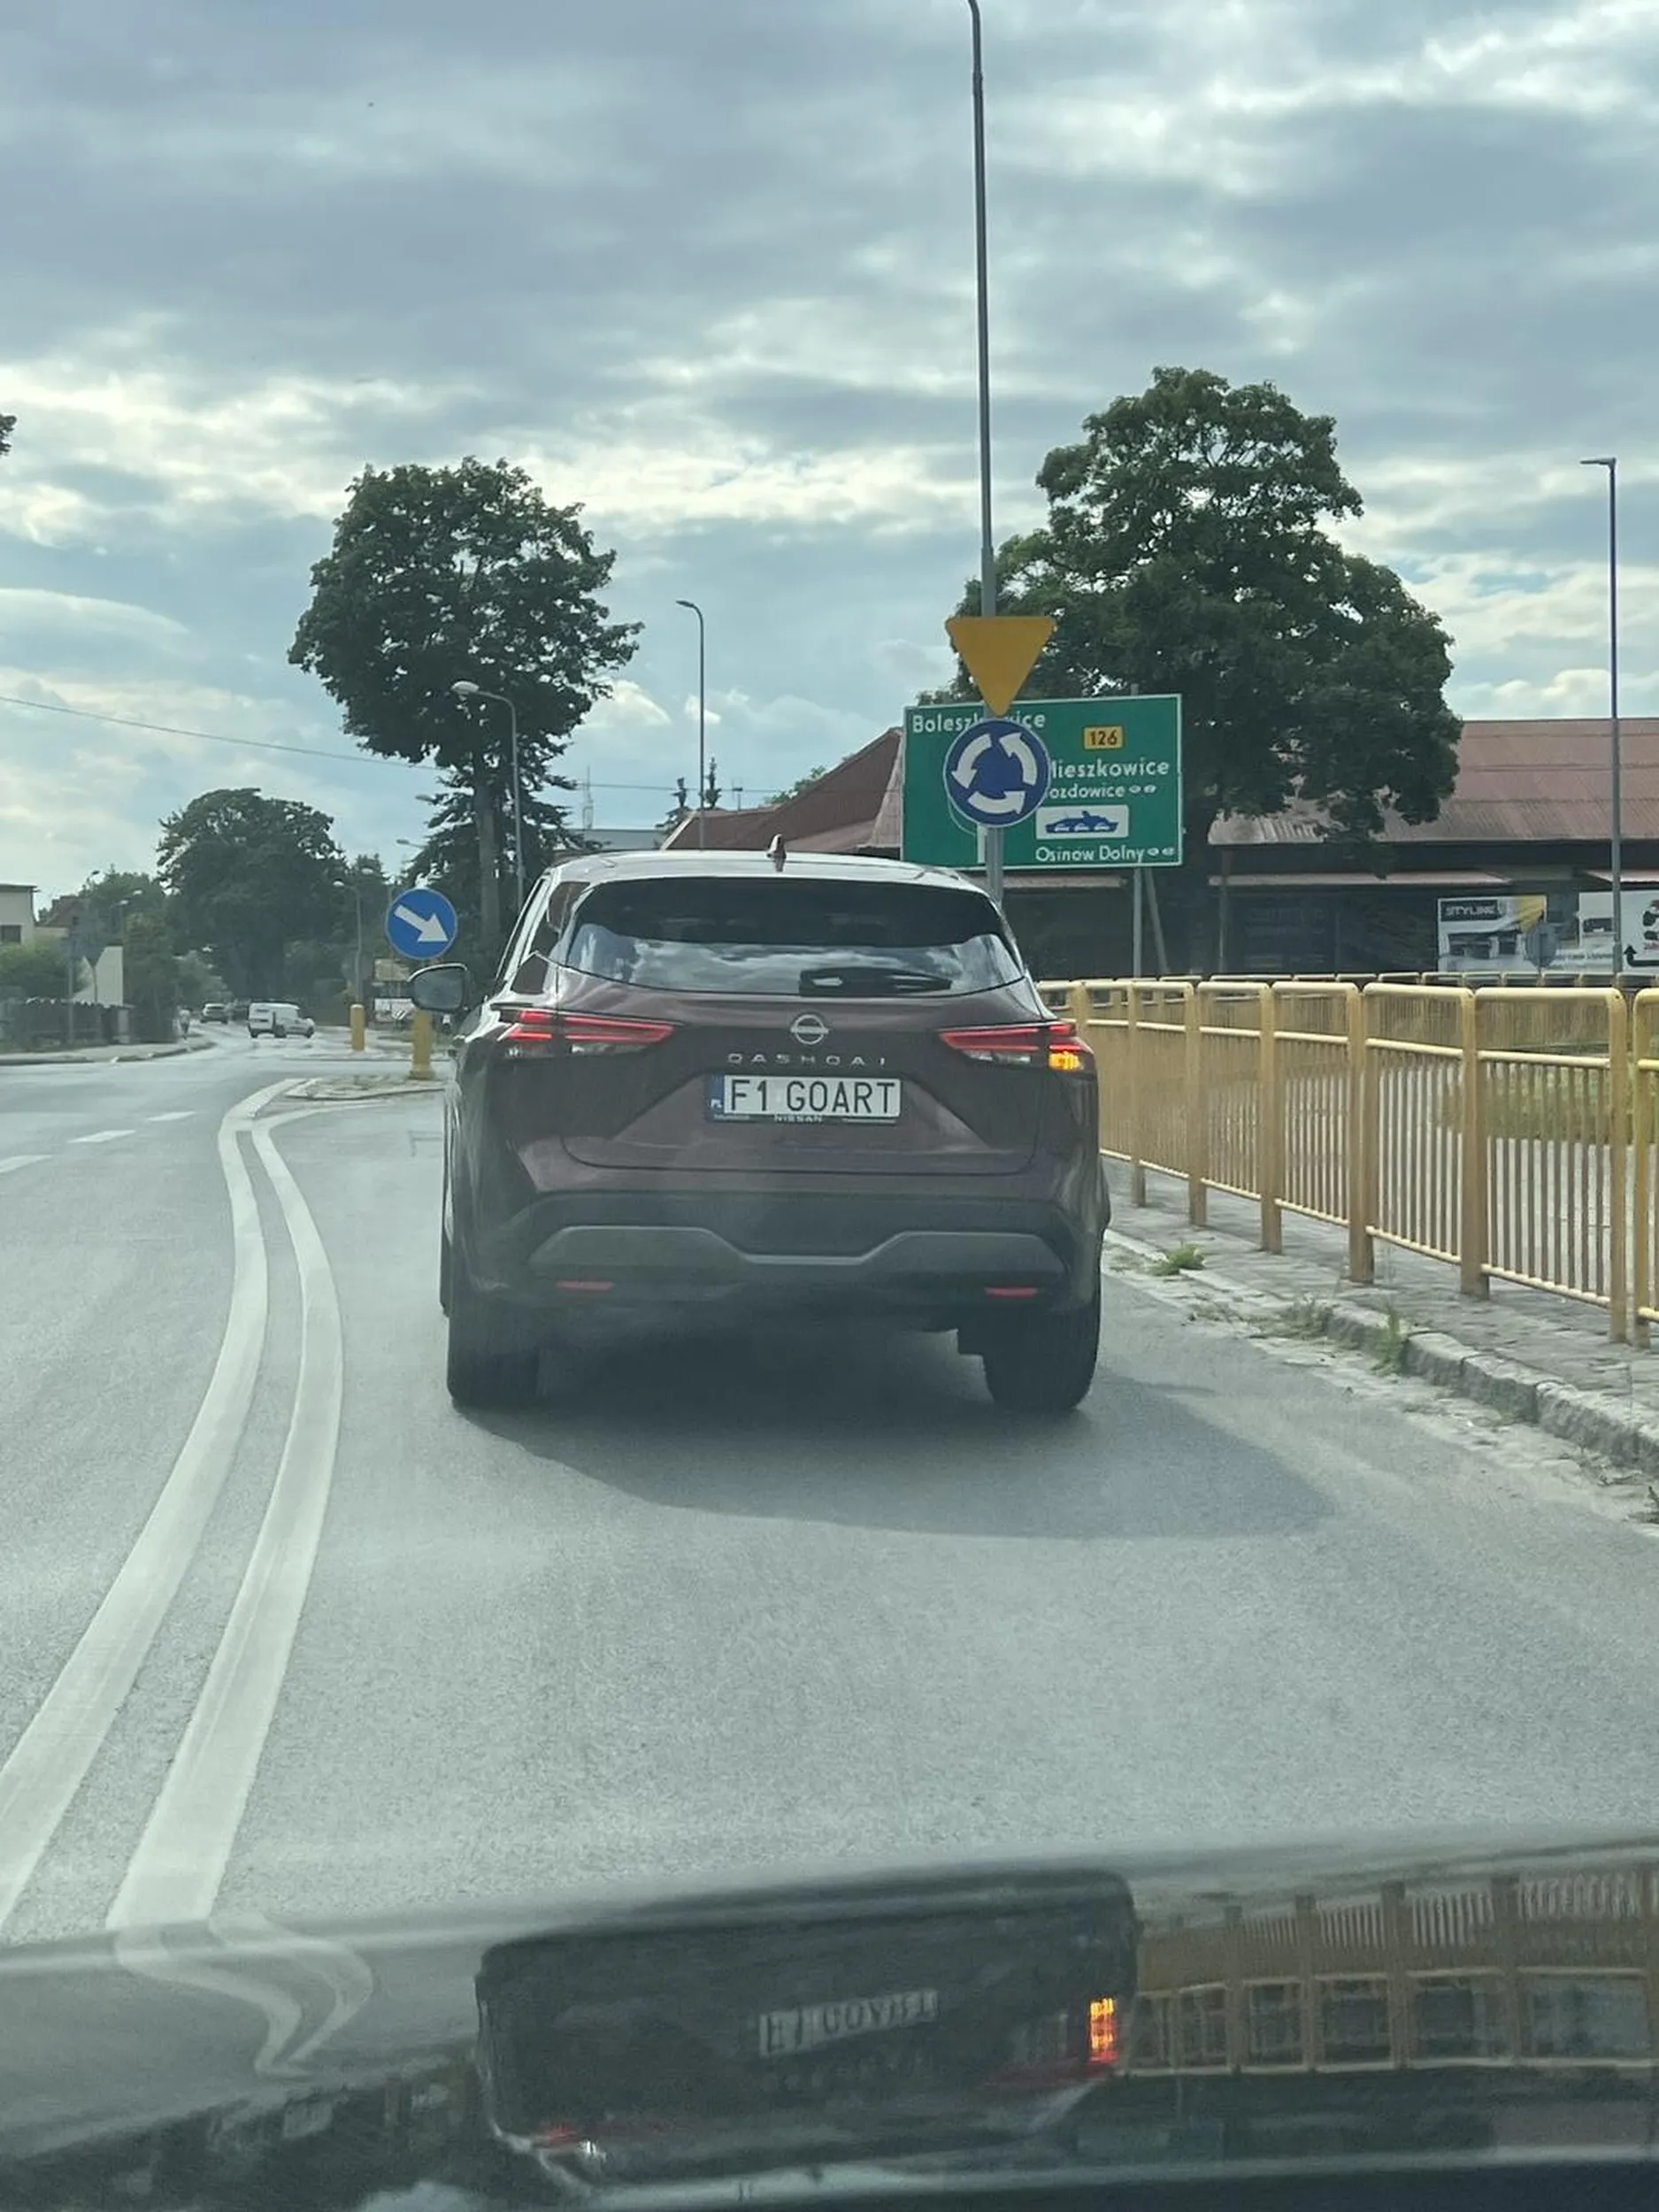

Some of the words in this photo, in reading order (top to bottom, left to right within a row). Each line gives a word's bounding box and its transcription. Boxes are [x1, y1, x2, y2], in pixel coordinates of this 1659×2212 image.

[1089, 729, 1118, 746] 126
[1047, 783, 1125, 799] ozdowice
[1099, 844, 1145, 864] Dolny
[731, 1079, 767, 1111] F1
[787, 1079, 895, 1114] GOART
[774, 1115, 823, 1124] NISSAN
